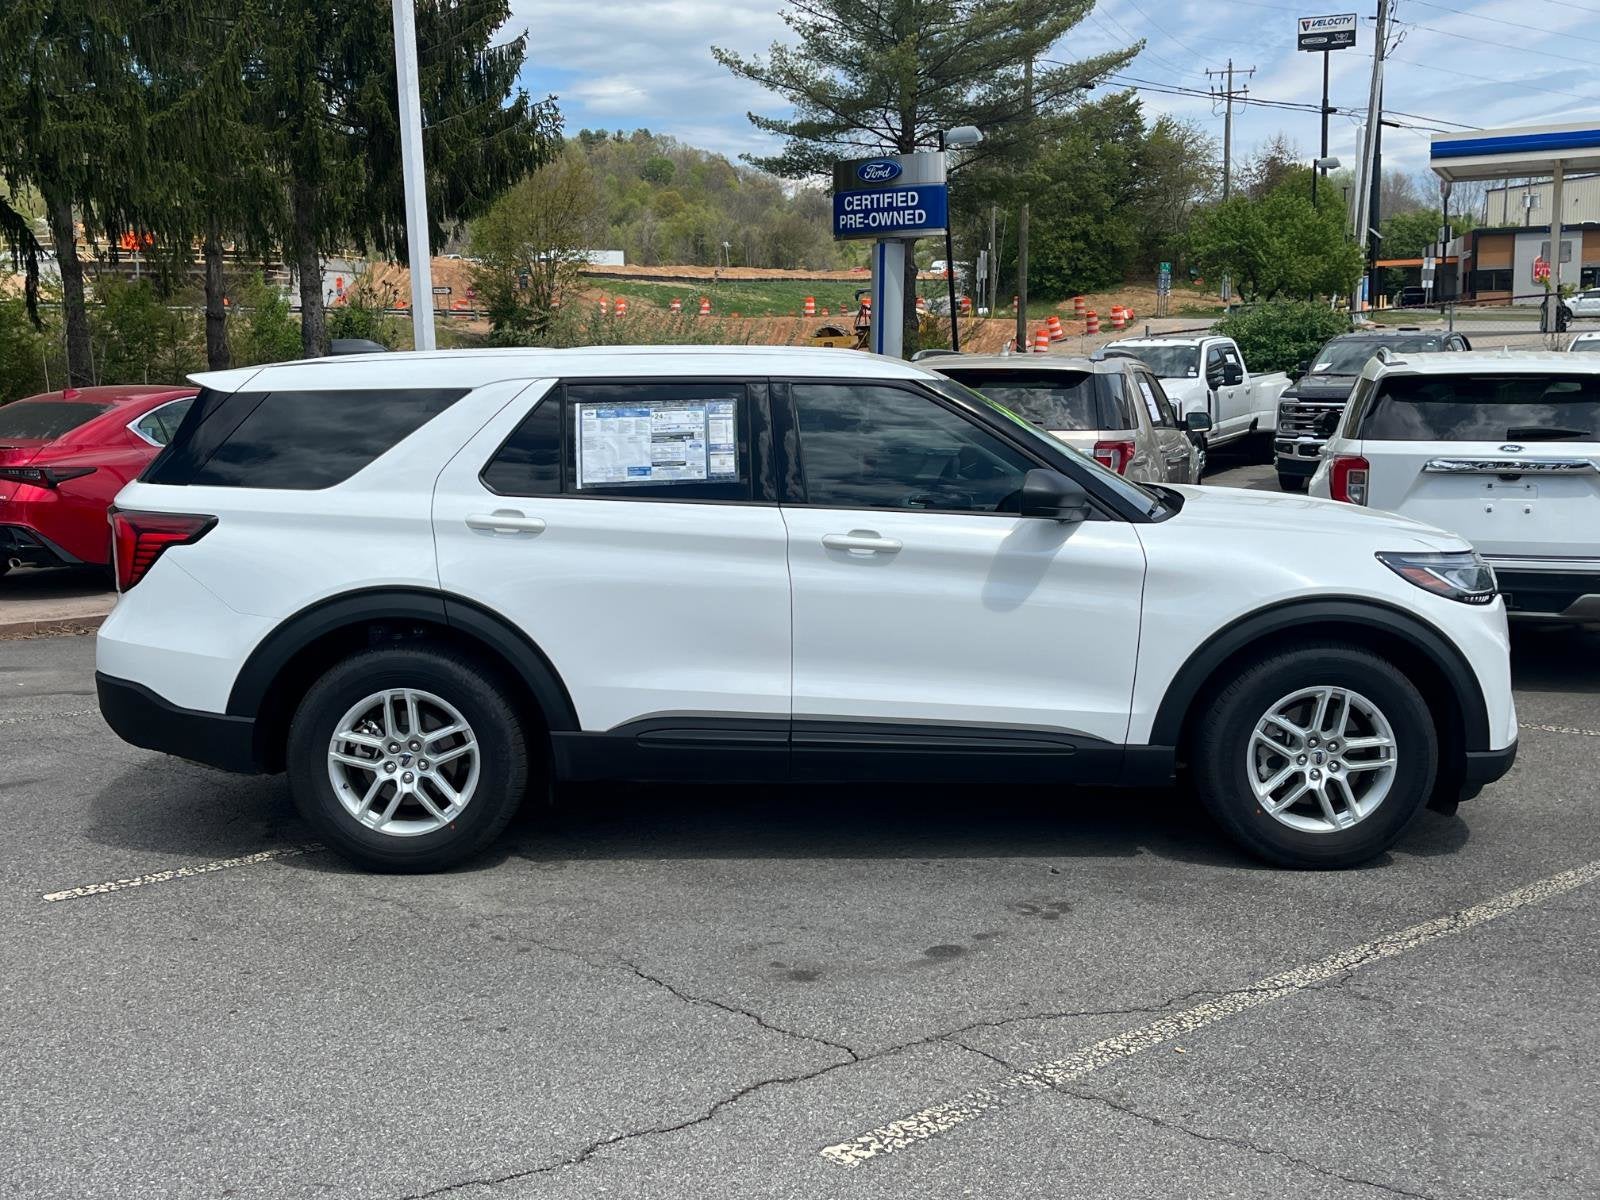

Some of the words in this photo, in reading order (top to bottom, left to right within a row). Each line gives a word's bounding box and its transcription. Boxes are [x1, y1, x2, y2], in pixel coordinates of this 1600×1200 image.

[1311, 16, 1353, 27] VELOCITY
[864, 164, 892, 179] Ford
[844, 191, 919, 211] CERTIFIED
[839, 209, 927, 229] PRE-OWNED
